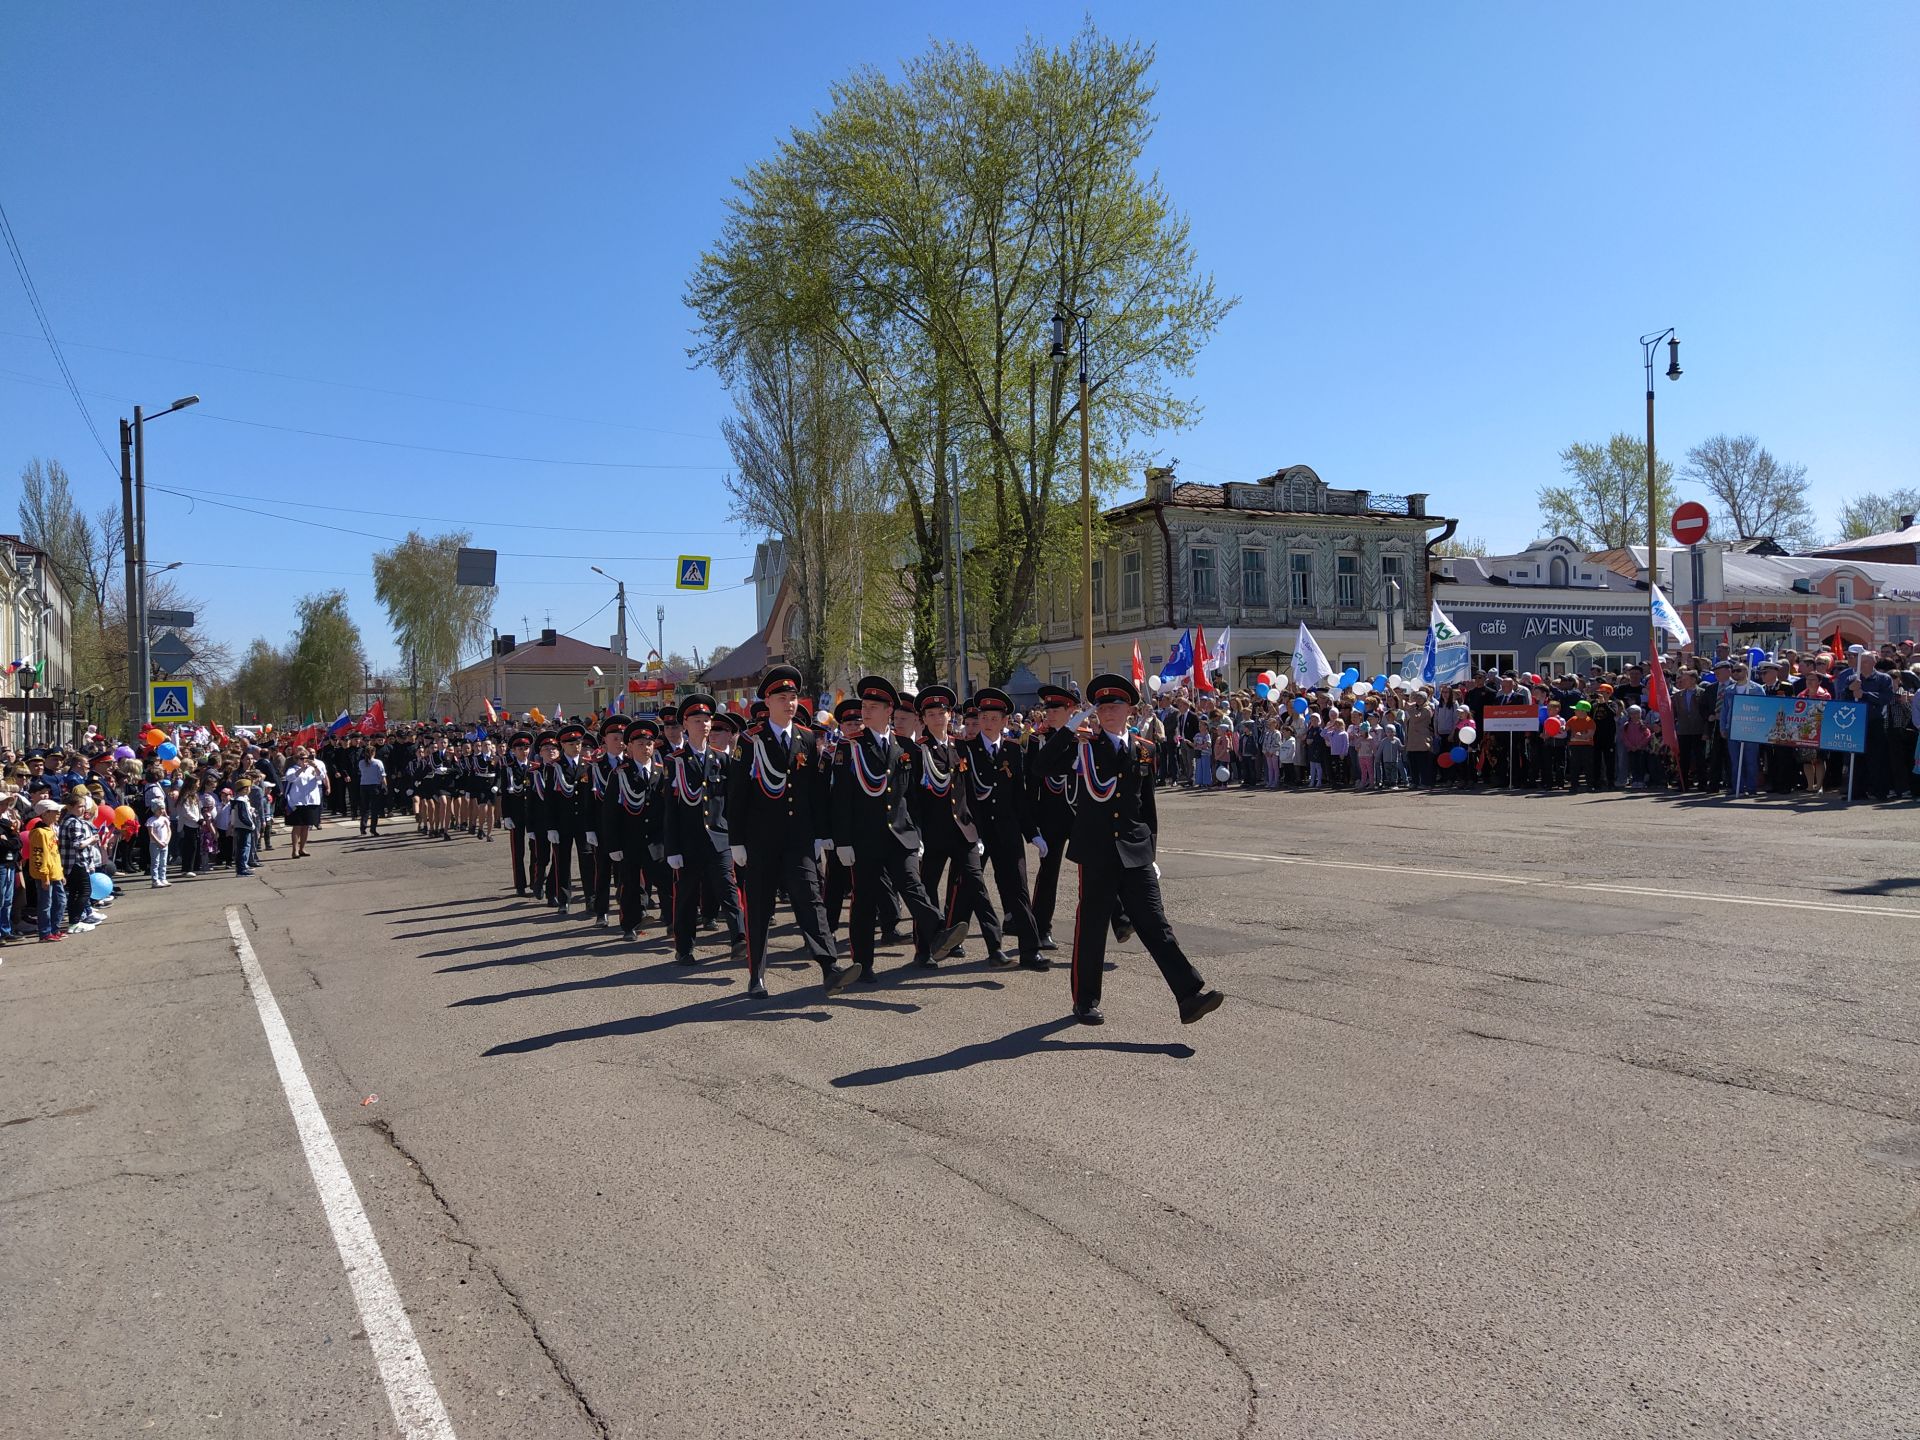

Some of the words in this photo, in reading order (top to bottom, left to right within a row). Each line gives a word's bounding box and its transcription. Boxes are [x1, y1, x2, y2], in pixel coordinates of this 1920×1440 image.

[1479, 620, 1507, 634] café
[1522, 617, 1594, 640] AVENUE
[1604, 622, 1633, 639] кафе
[1794, 700, 1807, 714] 9
[1834, 733, 1852, 741] НТЦ
